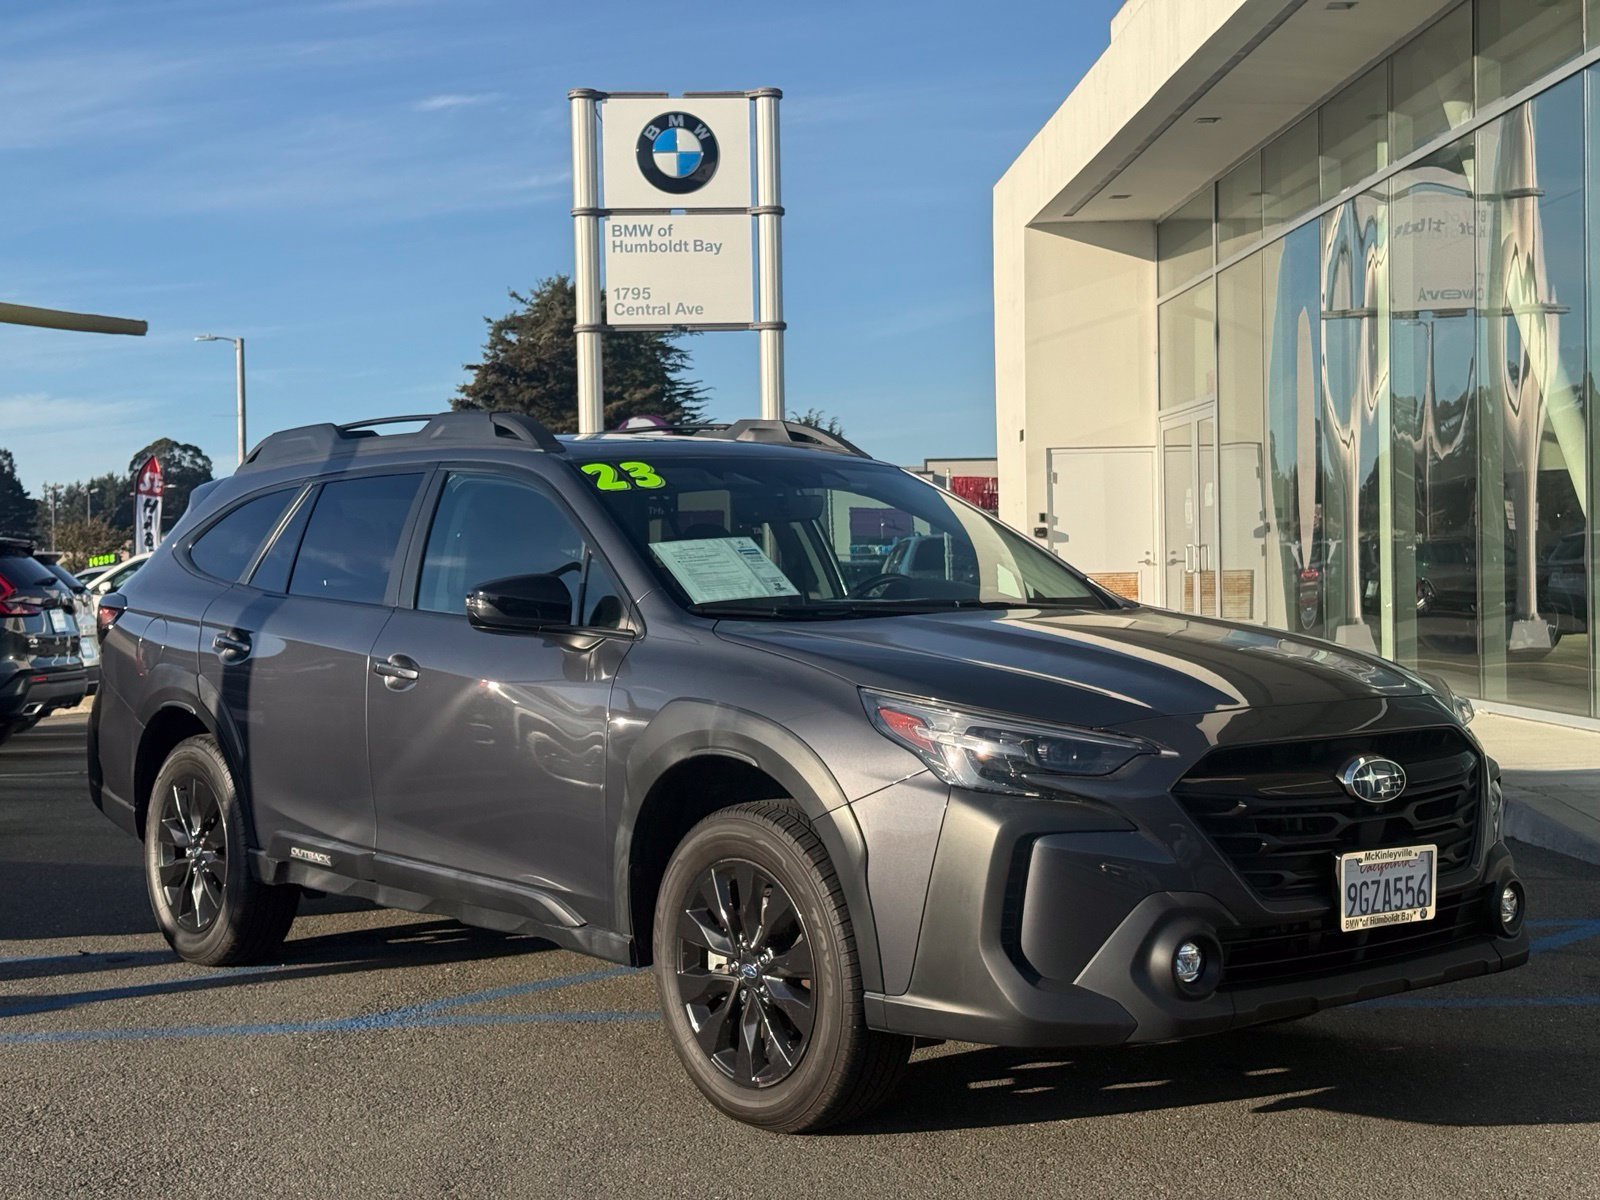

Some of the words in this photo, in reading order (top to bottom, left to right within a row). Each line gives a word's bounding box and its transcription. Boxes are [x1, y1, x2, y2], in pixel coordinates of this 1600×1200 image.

[644, 114, 711, 141] BMW
[611, 224, 653, 237] BMW
[658, 223, 673, 237] of
[612, 240, 689, 253] Humboldt
[693, 240, 722, 255] Bay
[614, 287, 651, 300] 1795
[613, 302, 671, 316] Central
[675, 302, 704, 315] Ave
[581, 461, 666, 491] 23
[291, 847, 332, 866] OUTBACK
[1364, 848, 1412, 861] McKinleyville
[1347, 873, 1427, 917] 9GZA556
[1345, 920, 1359, 929] BMW
[1362, 918, 1368, 926] of
[1370, 914, 1400, 925] Humboldt
[1401, 911, 1414, 922] Bay
